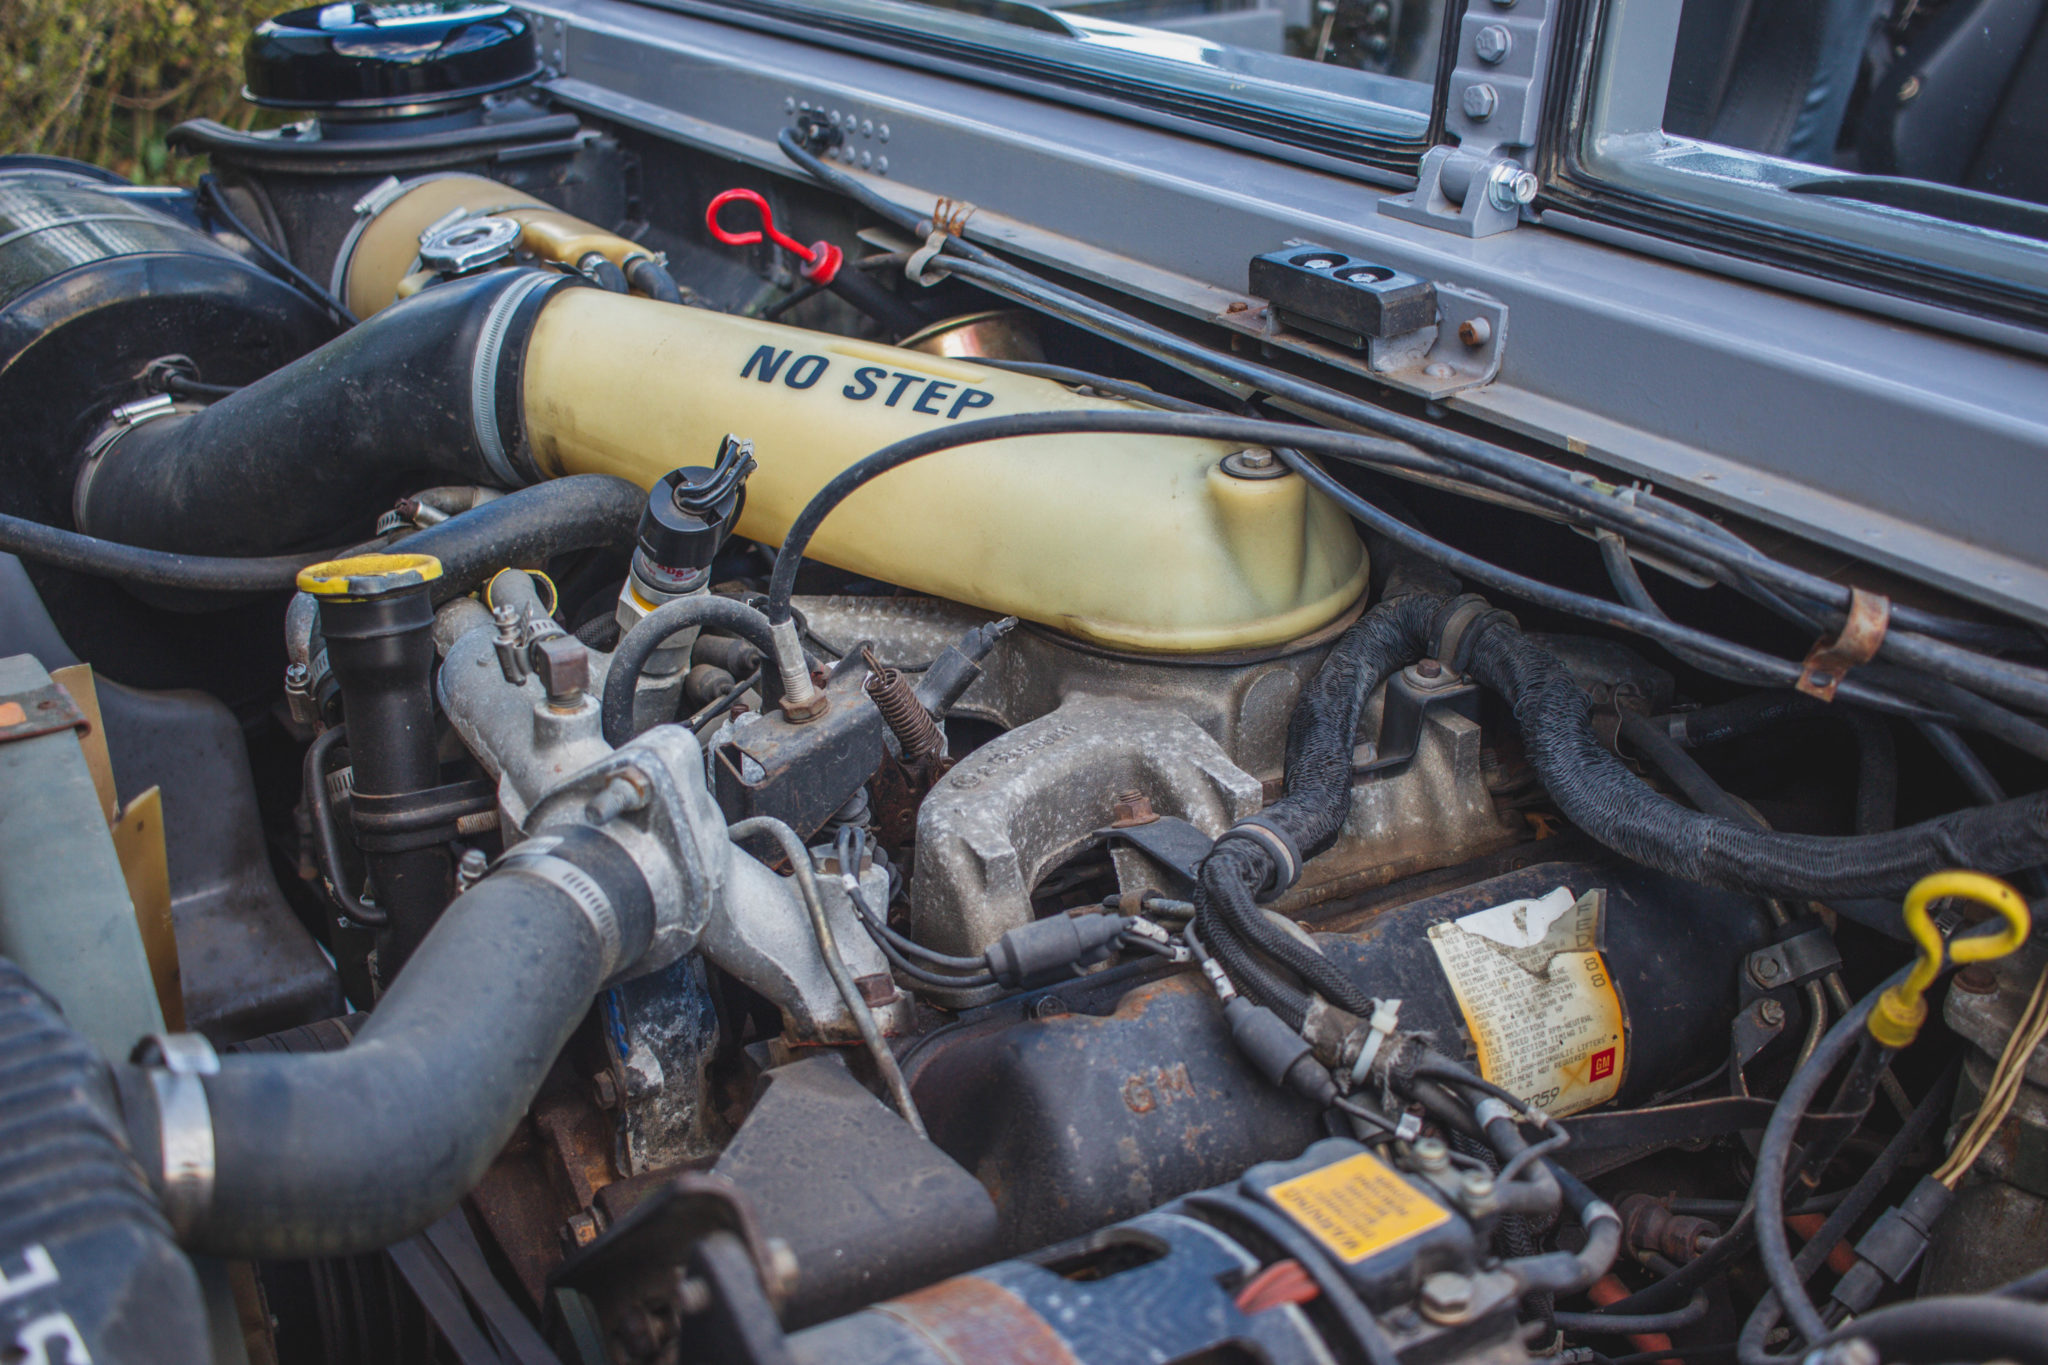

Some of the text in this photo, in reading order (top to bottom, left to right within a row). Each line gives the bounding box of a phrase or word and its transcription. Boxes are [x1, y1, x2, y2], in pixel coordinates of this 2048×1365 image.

[740, 345, 994, 420] NO STEP
[1122, 1062, 1196, 1113] GM
[1596, 1055, 1611, 1072] GM
